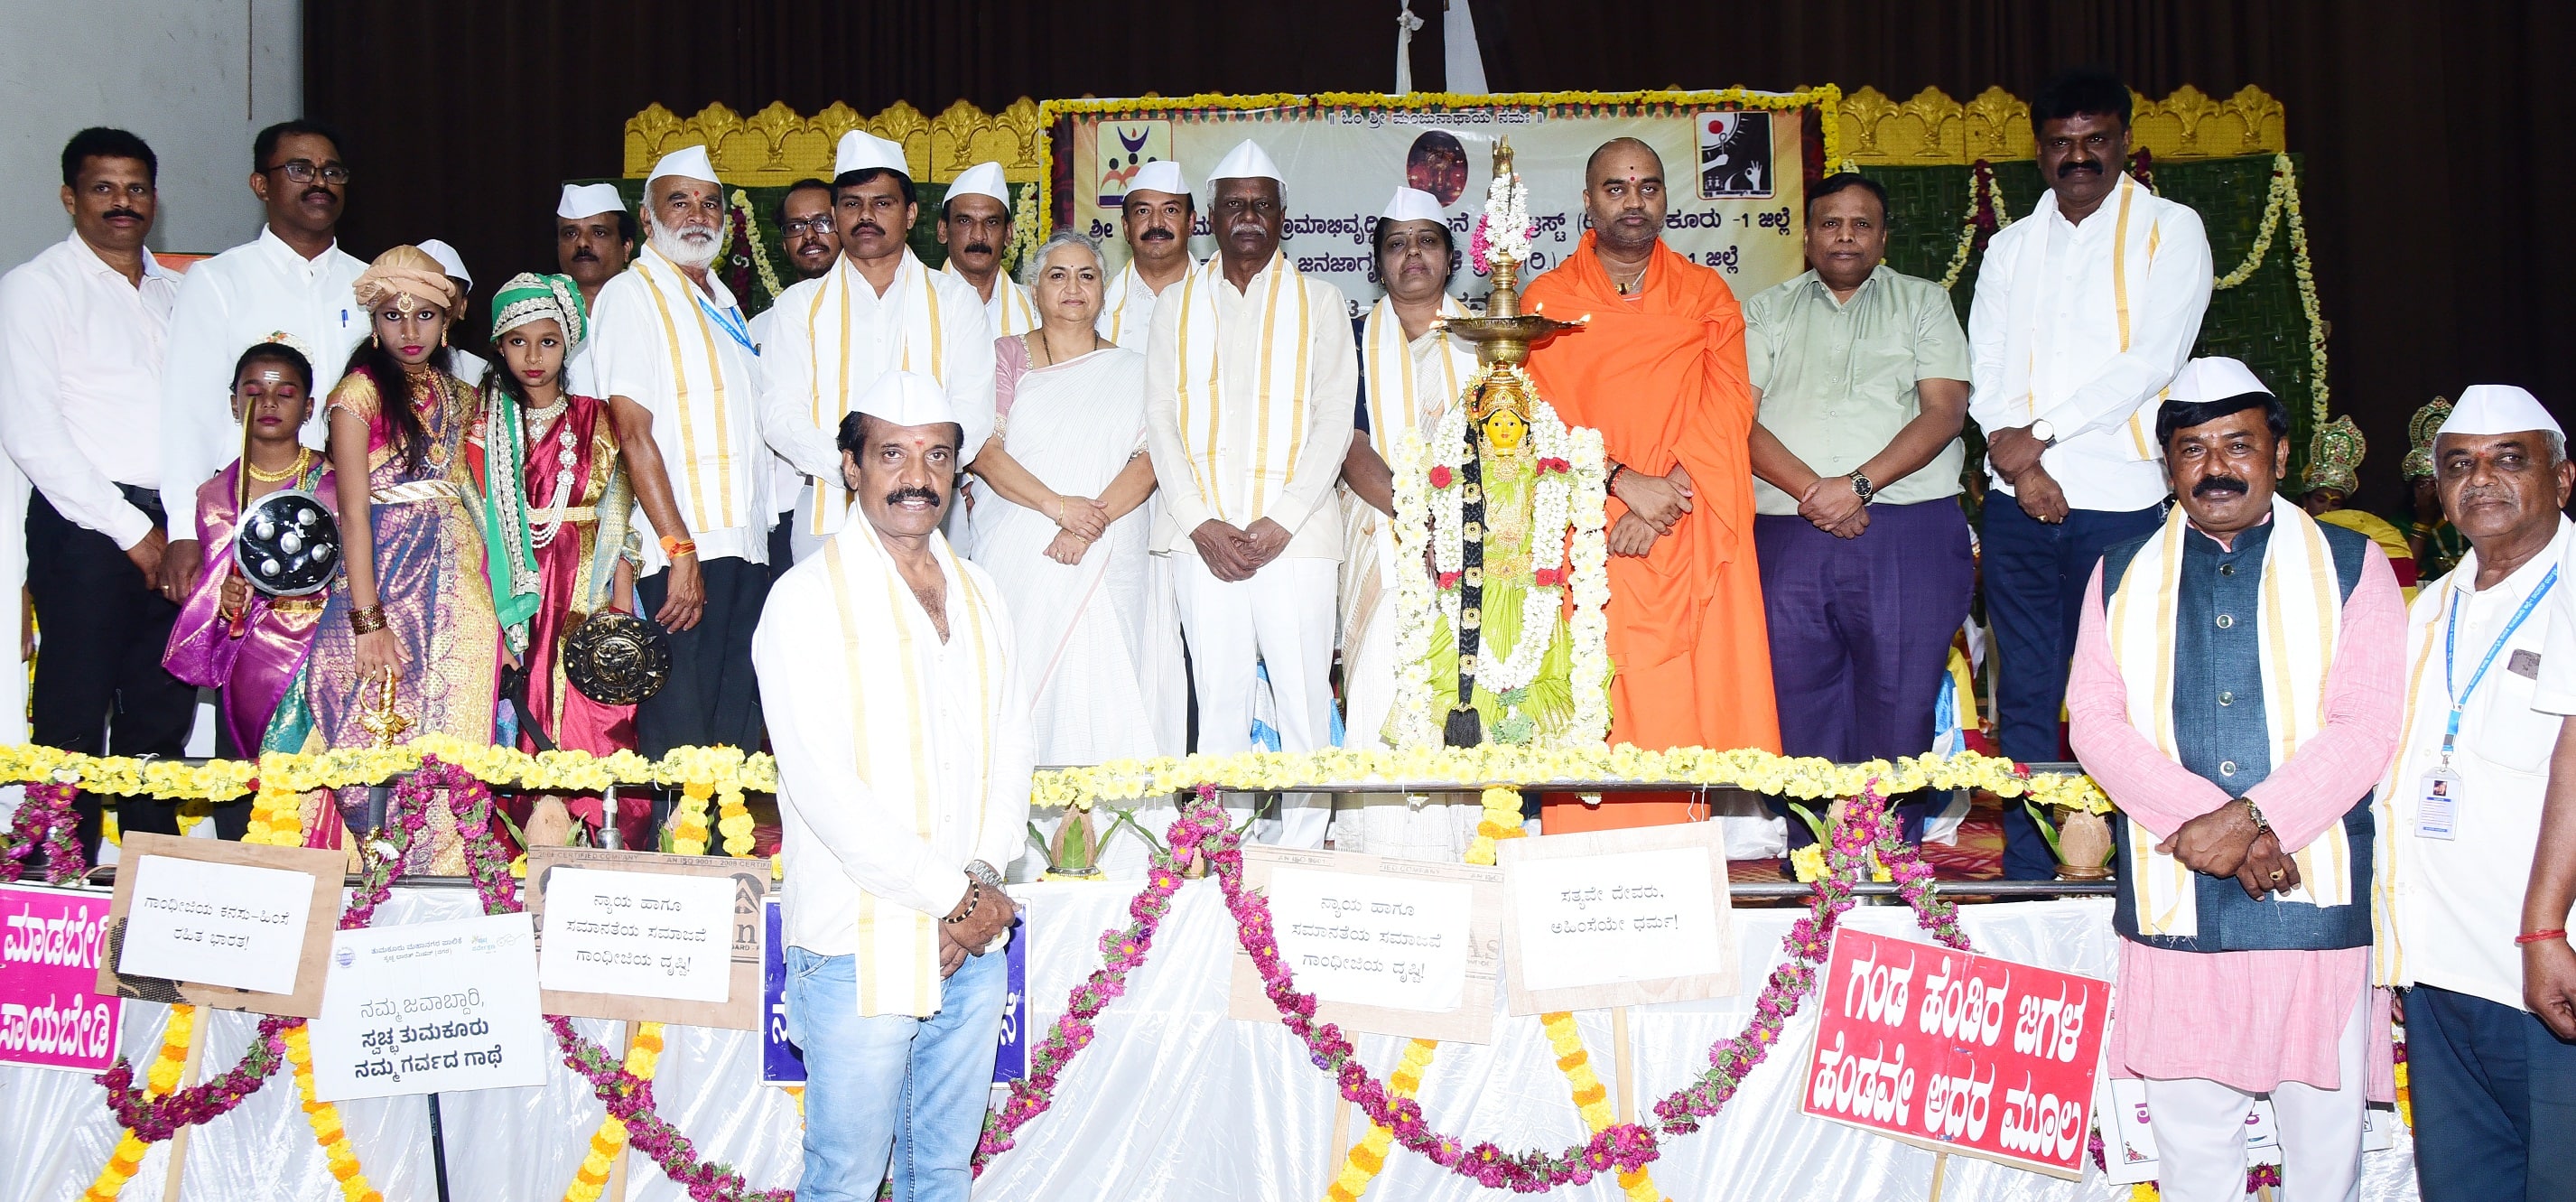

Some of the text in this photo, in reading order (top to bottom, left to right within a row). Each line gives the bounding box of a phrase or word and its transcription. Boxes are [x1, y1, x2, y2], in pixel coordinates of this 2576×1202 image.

[1341, 112, 1362, 125] ಓಂ
[1368, 112, 1386, 128] ಶ್ರೀ
[1392, 112, 1491, 126] ಮಂಜುನಾಥಾಯ
[1498, 112, 1530, 125] ನಮಃ
[1088, 218, 1113, 246] ಶ್ರೀ
[1758, 207, 1790, 236] ಜಿಲ್ಲೆ
[1706, 246, 1738, 274] ಜಿಲ್ಲೆ
[144, 897, 213, 916] ಗಾಂಧೀಜಿಯ
[593, 893, 683, 914] ನ್ಯಾಯ ಹಾಗೂ
[1320, 896, 1415, 918] ನ್ಯಾಯ ಹಾಗೂ
[1560, 886, 1604, 909] ಸತ್ಯವೇ
[565, 919, 639, 937] ಸಮಾನತೆಯ
[1291, 922, 1371, 942] ಸಮಾನತೆಯ
[1550, 914, 1679, 934] ಅಹಿಂಸೆಯೇ ಧರ್ಮ!
[173, 927, 250, 951] ರಹಿತ ಭಾರತ!
[576, 948, 652, 967] ಗಾಂಧೀಜಿಯ
[1302, 953, 1384, 973] ಗಾಂಧೀಜಿಯ
[360, 998, 403, 1022] ನಮ್ಮ
[1844, 941, 2088, 1063] ಗಂಡ ಹೆಂಡಿರ ಜಗಳ
[361, 1017, 489, 1055] ಸ್ವಚ್ಛ ತುಮಕೂರು
[354, 1044, 503, 1083] ನಮ್ಮ ಗರ್ವದ ಗಾಥೆ
[1812, 1030, 2081, 1161] ಹೆಂಡವೇ ಅದರ ಮೂಲ
